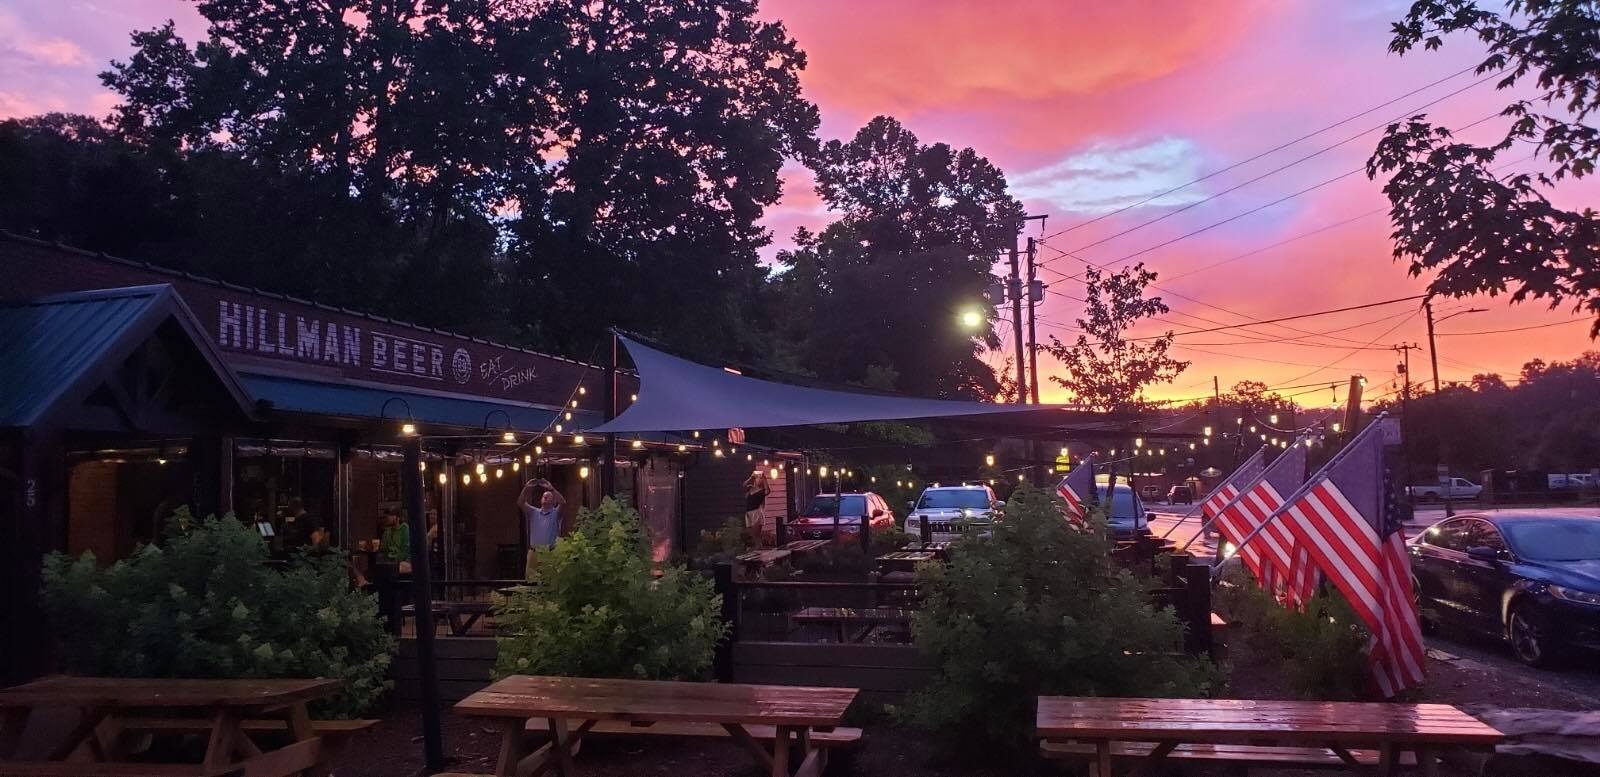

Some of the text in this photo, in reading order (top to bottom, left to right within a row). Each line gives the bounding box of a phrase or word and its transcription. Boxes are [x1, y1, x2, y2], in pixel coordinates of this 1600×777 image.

[218, 299, 361, 367] HILLMAN
[373, 335, 443, 376] BEER
[479, 355, 503, 380] EAT
[501, 366, 537, 391] DRINK
